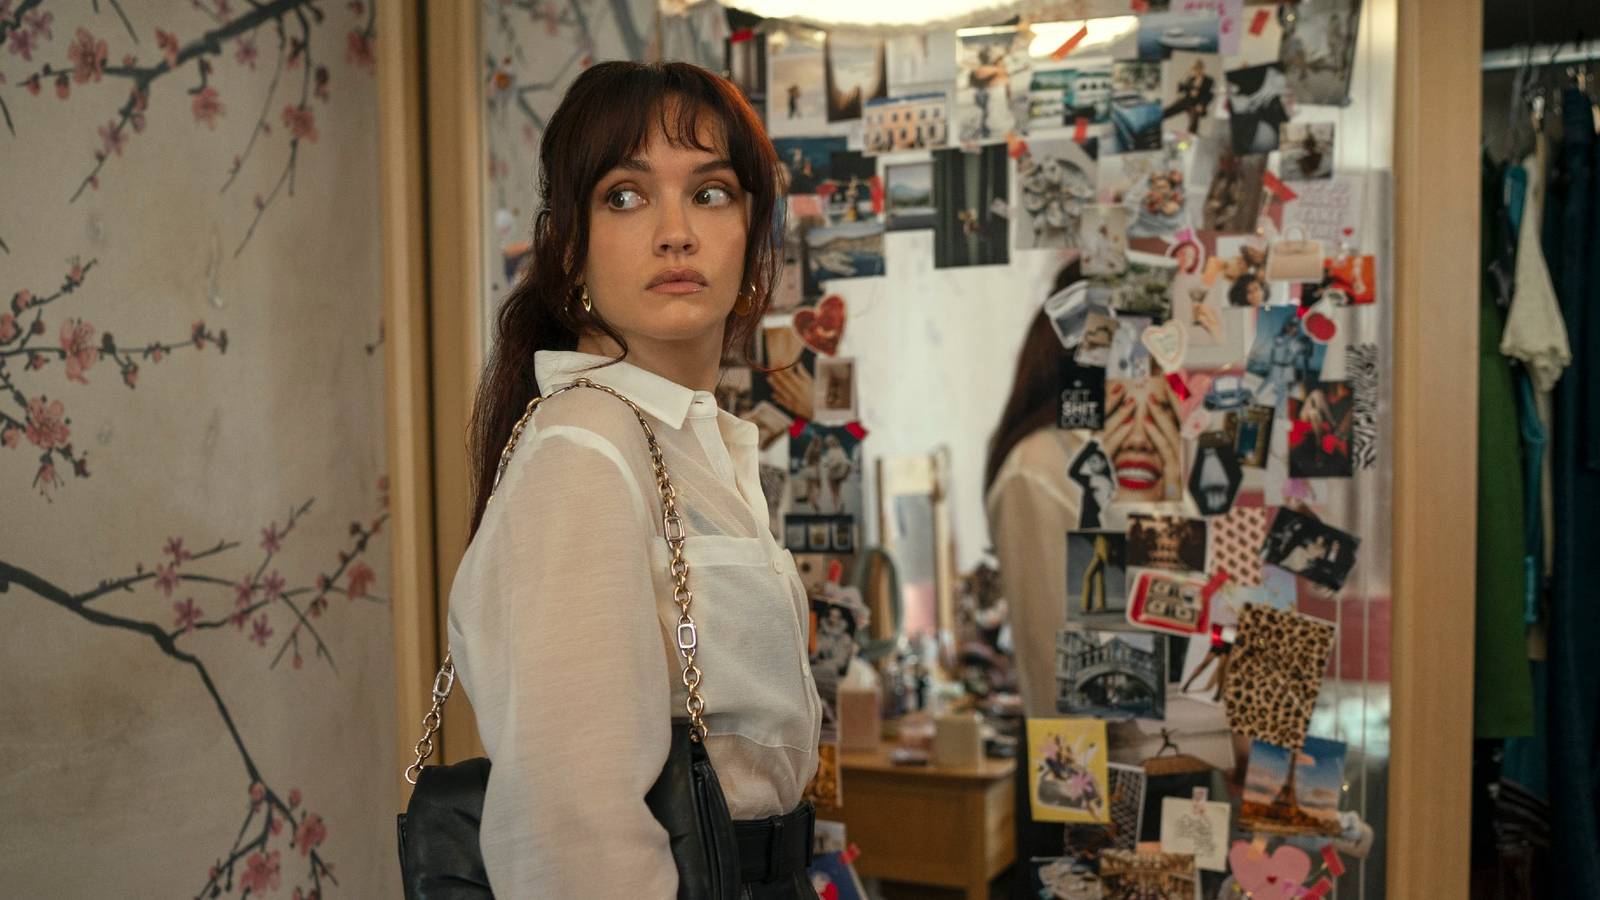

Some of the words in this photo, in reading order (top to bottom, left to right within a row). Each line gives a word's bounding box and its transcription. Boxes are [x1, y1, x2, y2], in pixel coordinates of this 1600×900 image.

[1061, 389, 1090, 402] GET
[1062, 402, 1098, 416] SHIT
[1061, 416, 1099, 428] DONE
